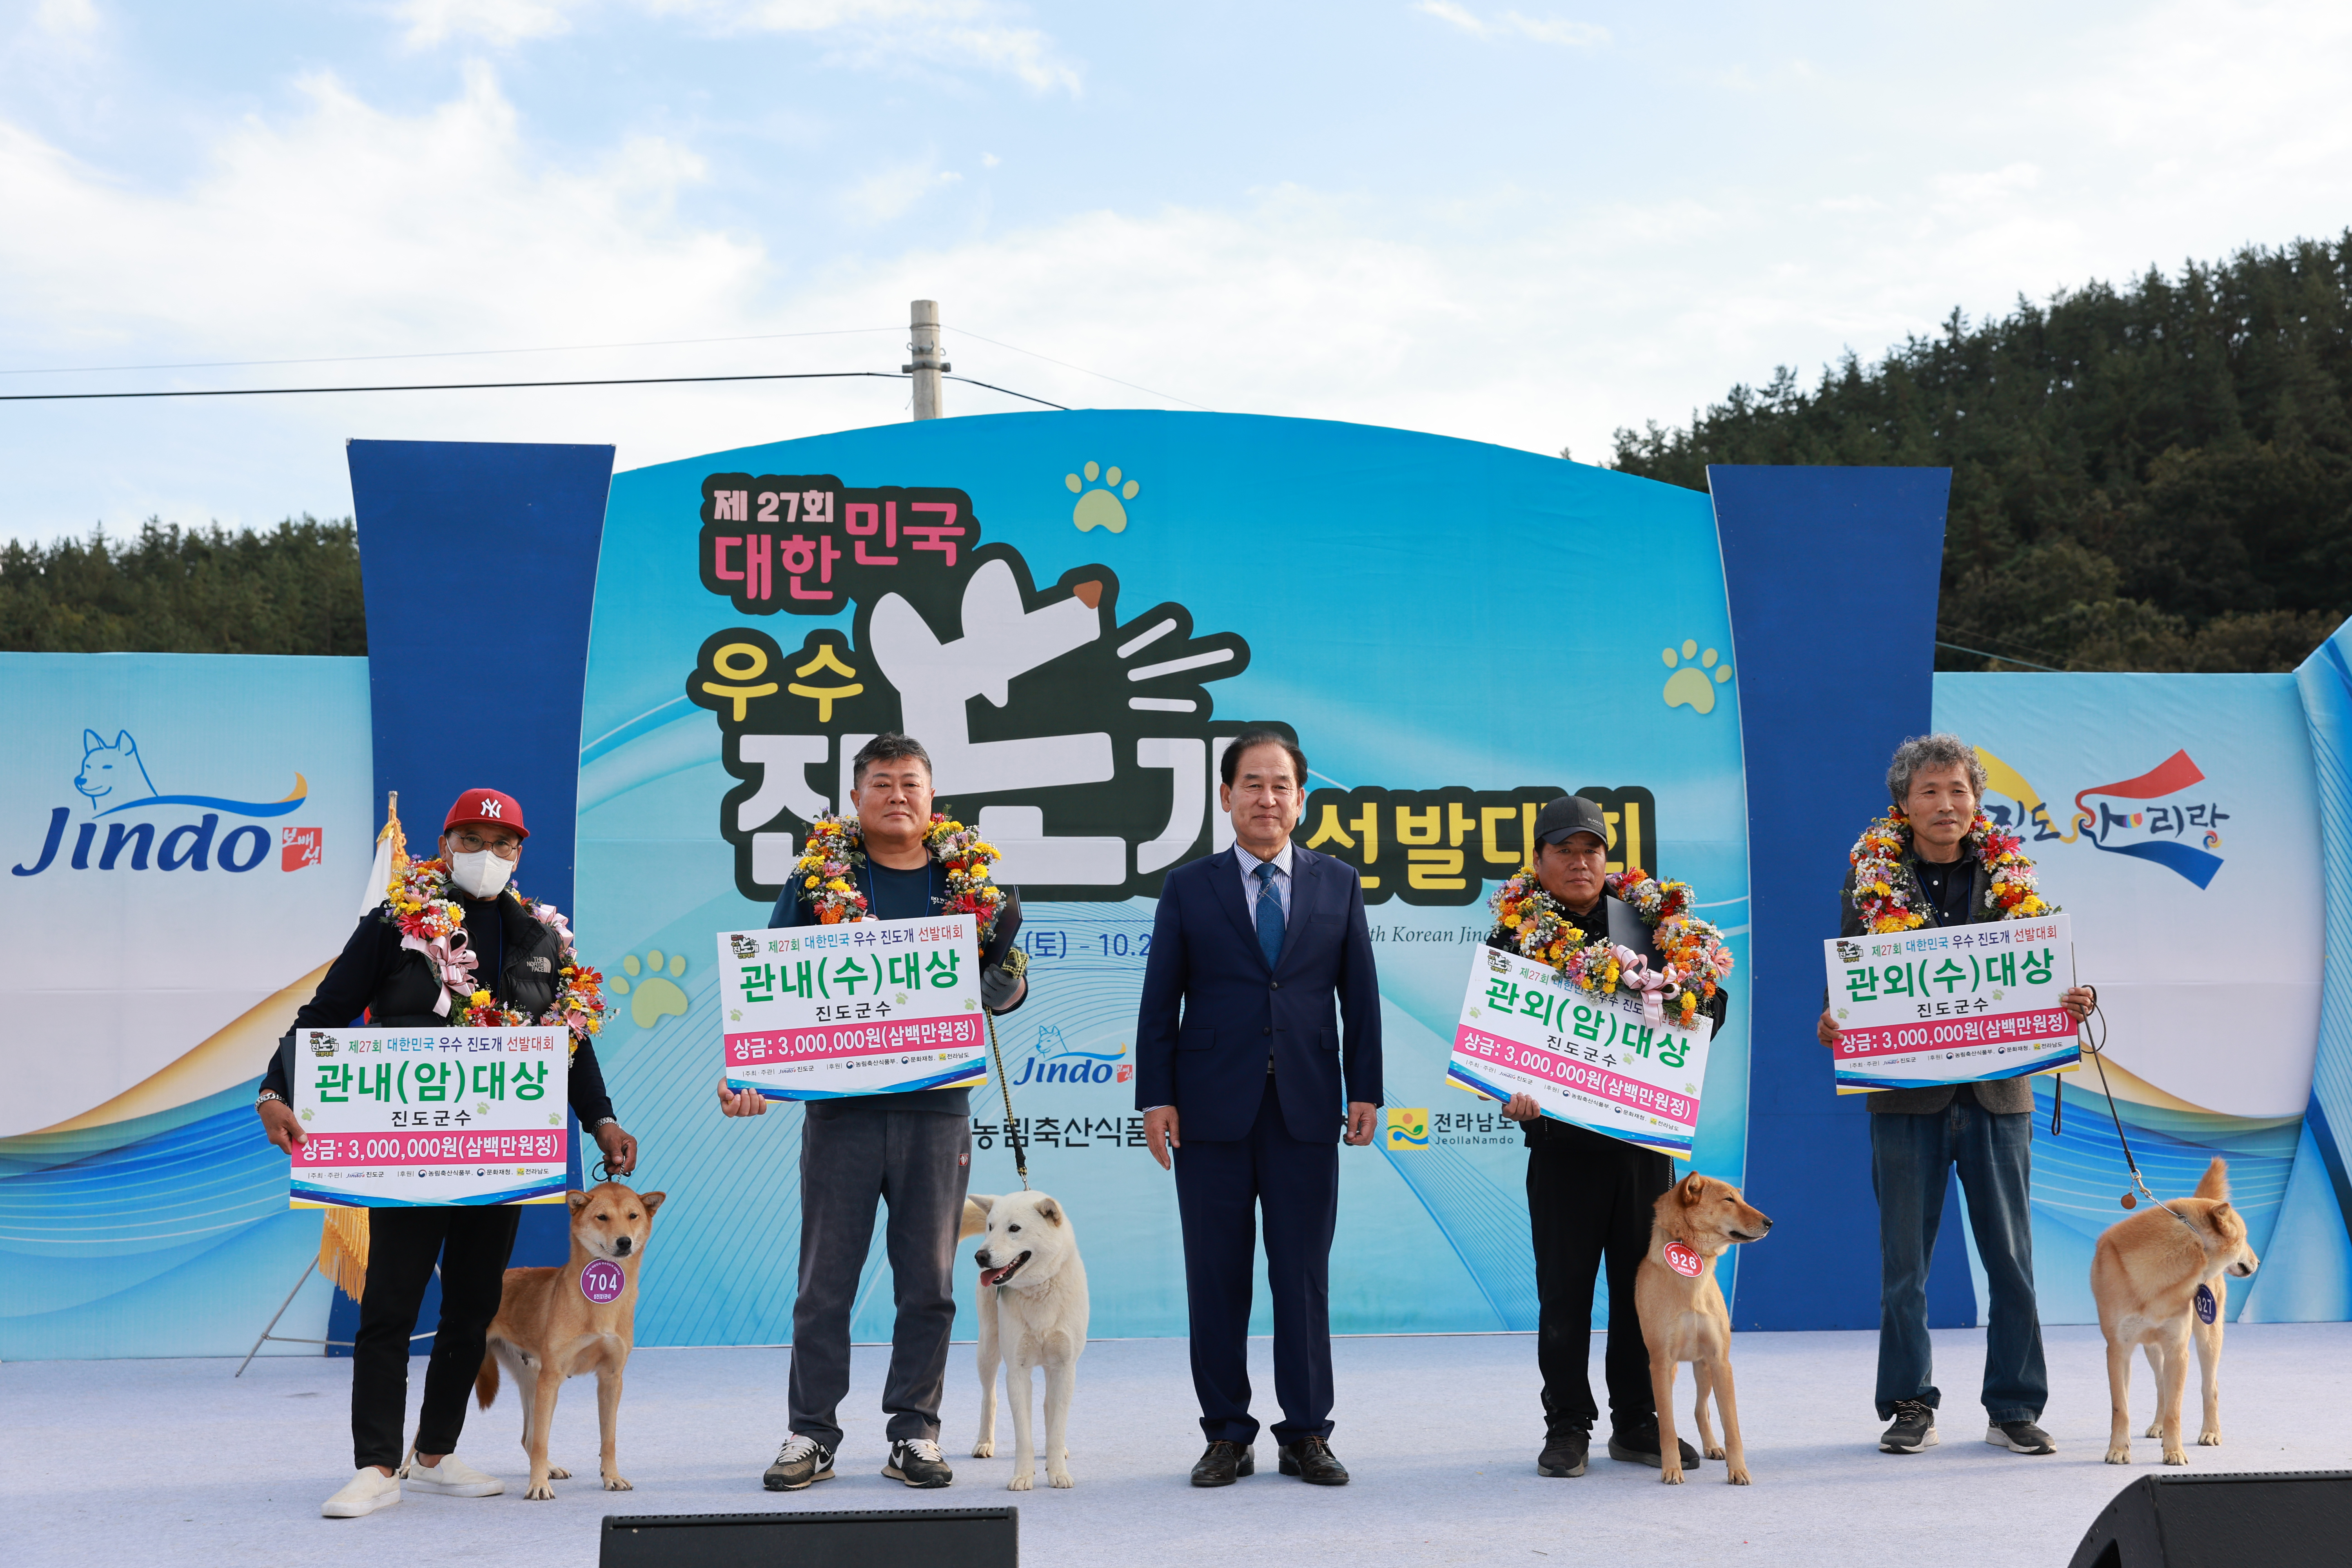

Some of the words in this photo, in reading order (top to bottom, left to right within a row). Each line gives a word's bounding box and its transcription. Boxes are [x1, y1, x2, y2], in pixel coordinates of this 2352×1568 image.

[714, 490, 748, 522] 제
[758, 489, 834, 523] 27회
[715, 501, 965, 600] 대한민국
[702, 643, 863, 722] 우수
[12, 807, 271, 877] Jindo
[768, 938, 799, 953] 제27회
[805, 933, 849, 949] 대한민국
[854, 931, 876, 947] 우수
[881, 928, 913, 945] 진도개
[918, 924, 962, 942] 선발대회
[1368, 926, 1385, 942] th
[1393, 926, 1454, 942] Korean
[1872, 943, 1901, 957] 제27회
[1906, 937, 1948, 952] 대한민국
[1953, 934, 1974, 949] 우수
[1978, 930, 2009, 946] 진도개
[2014, 925, 2056, 942] 선발대회
[740, 949, 960, 1002] 관내(수)대상
[1846, 948, 2054, 1002] 관외(수)대상
[1519, 967, 1550, 985] 제27회
[1552, 976, 1584, 995] 대한민
[1622, 998, 1643, 1015] 진도
[816, 1001, 891, 1022] 진도군수
[1917, 998, 1988, 1018] 진도군수
[1485, 978, 1690, 1067] 관외(암)대상
[348, 1040, 381, 1053] 제27회
[387, 1037, 434, 1051] 대한민국
[439, 1037, 462, 1053] 우수
[467, 1036, 502, 1052] 진도개
[507, 1036, 553, 1051] 선발대회
[734, 1038, 772, 1059] 상금:
[1464, 1033, 1501, 1056] 상금:
[1547, 1035, 1616, 1067] 진도군수
[1840, 1033, 1877, 1053] 상금:
[315, 1060, 548, 1104] 관내(암)대상
[1013, 1057, 1112, 1085] Jindo
[1517, 1076, 1532, 1085] 진도군
[392, 1110, 471, 1127] 진도군수
[1434, 1112, 1515, 1133] 전라남도
[1658, 1121, 1678, 1131] 전라남도
[972, 1117, 1171, 1150] 농림축산식품
[1434, 1135, 1514, 1145] JeollaNamdo
[301, 1140, 342, 1160] 상금:
[1671, 1251, 1697, 1269] 926
[589, 1274, 617, 1291] 704
[2197, 1296, 2211, 1314] 827
